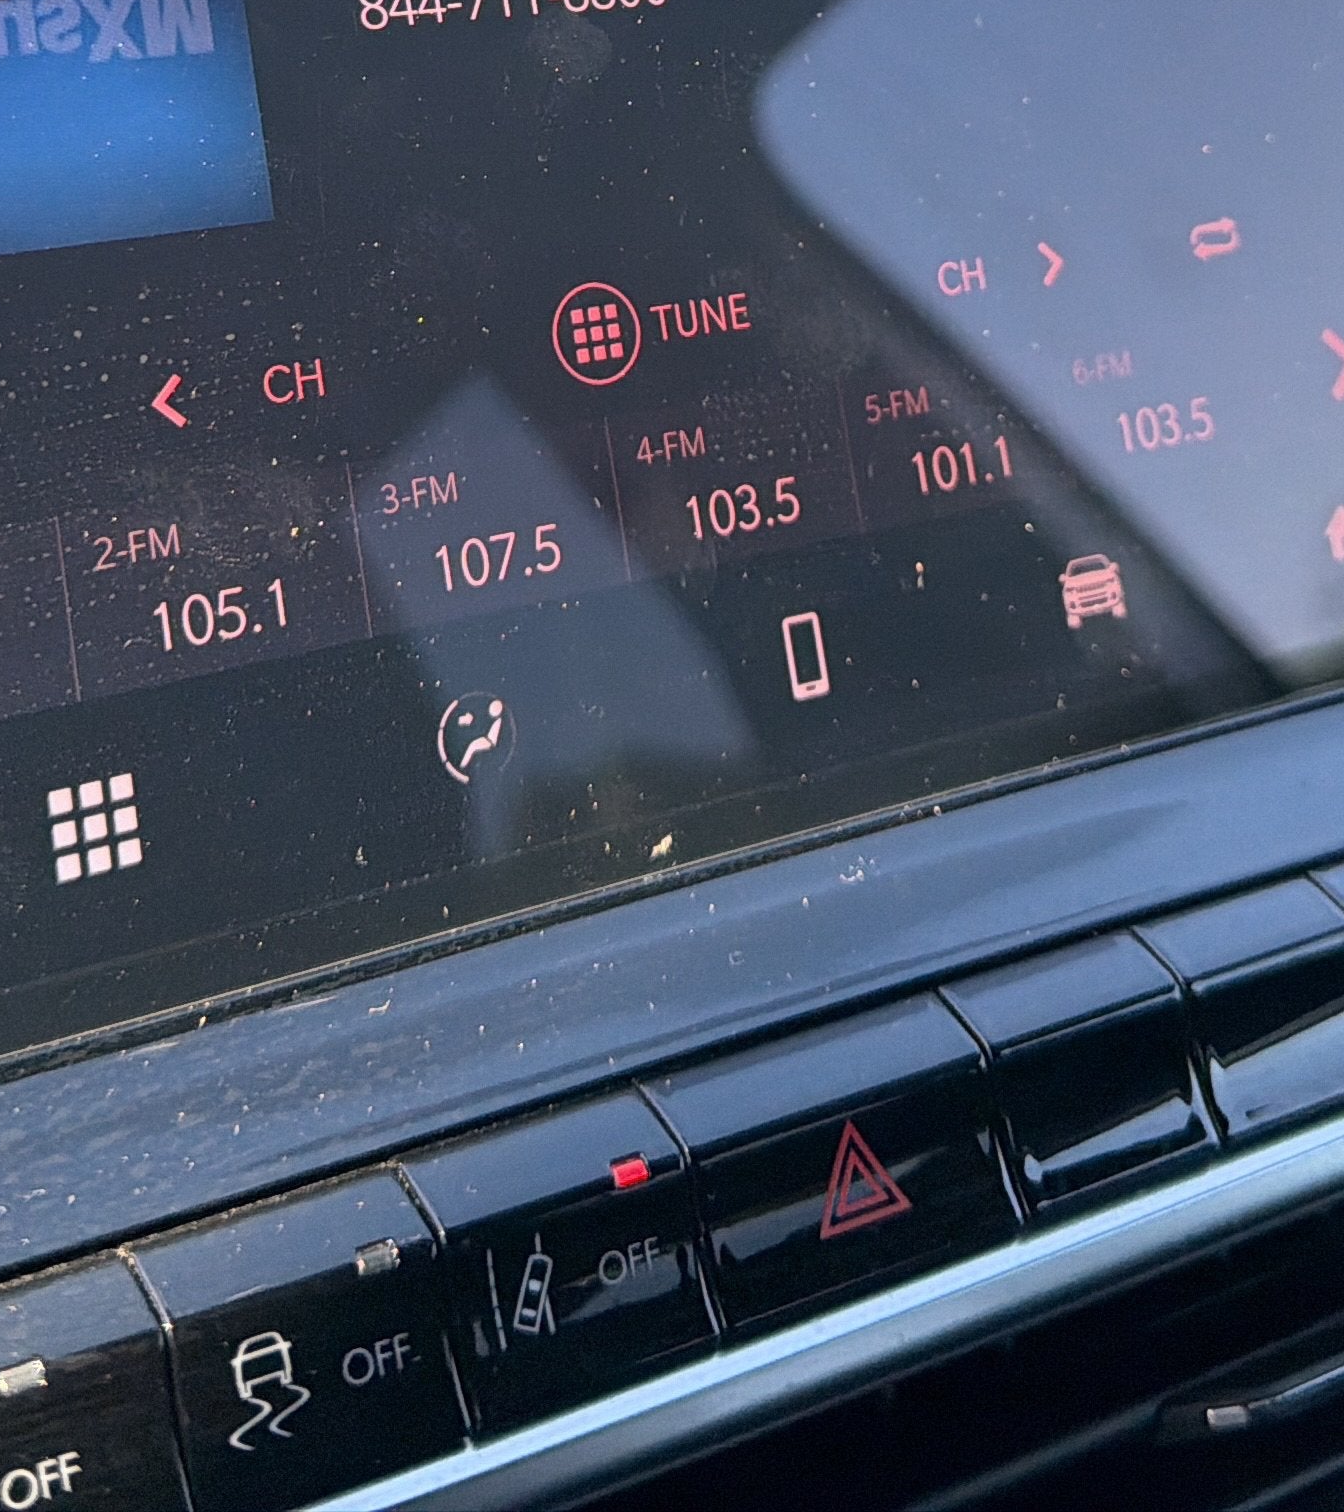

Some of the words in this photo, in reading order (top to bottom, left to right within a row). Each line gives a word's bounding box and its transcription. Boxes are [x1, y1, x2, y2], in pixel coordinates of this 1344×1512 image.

[937, 257, 987, 297] CH
[650, 292, 752, 342] TUNE
[263, 359, 325, 404] CH
[1072, 350, 1132, 384] 6-FM
[865, 387, 930, 424] 5-FM
[1117, 397, 1216, 453] 103.5
[636, 427, 707, 466] 4-FM
[911, 436, 1013, 494] 101.1
[380, 473, 458, 514] 3-FM
[686, 477, 801, 539] 103.5
[93, 523, 181, 572] 2-FM
[435, 523, 562, 591] 107.5
[154, 579, 288, 651] 105.1
[598, 1236, 662, 1287] OFF
[342, 1332, 410, 1387] OFF
